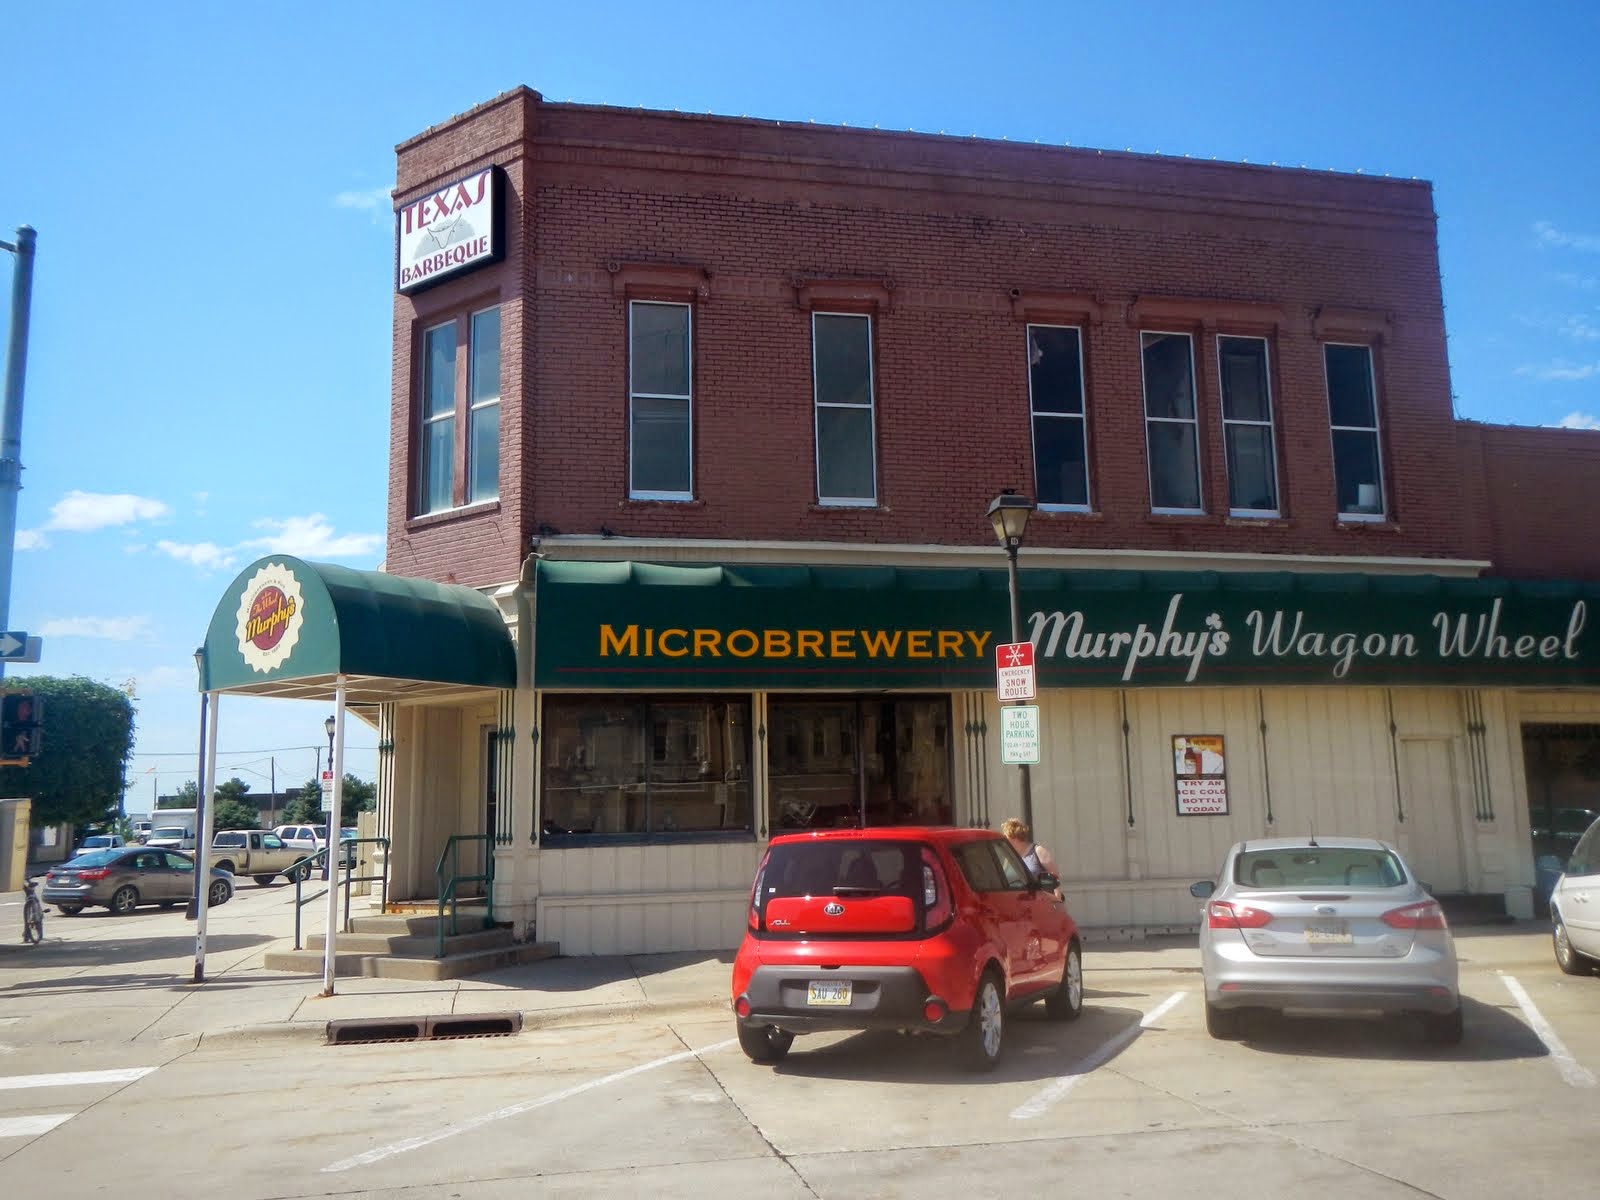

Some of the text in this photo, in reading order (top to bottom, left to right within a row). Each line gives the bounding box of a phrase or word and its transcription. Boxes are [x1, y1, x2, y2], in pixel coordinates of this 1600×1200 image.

[402, 169, 490, 235] TEXAS
[401, 235, 488, 284] BARBEQUE
[599, 623, 993, 659] MICROBREWERY
[1027, 593, 1587, 683] Murphy's Wagon Wheel
[1001, 669, 1030, 677] EMERGENCY
[1006, 678, 1026, 687] SNOW
[1005, 687, 1028, 696] ROUTE
[1012, 711, 1027, 719] TWO
[1009, 720, 1030, 729] HOUR
[1006, 730, 1035, 739] PARKING
[827, 905, 842, 914] KIA
[810, 988, 828, 1000] SAU
